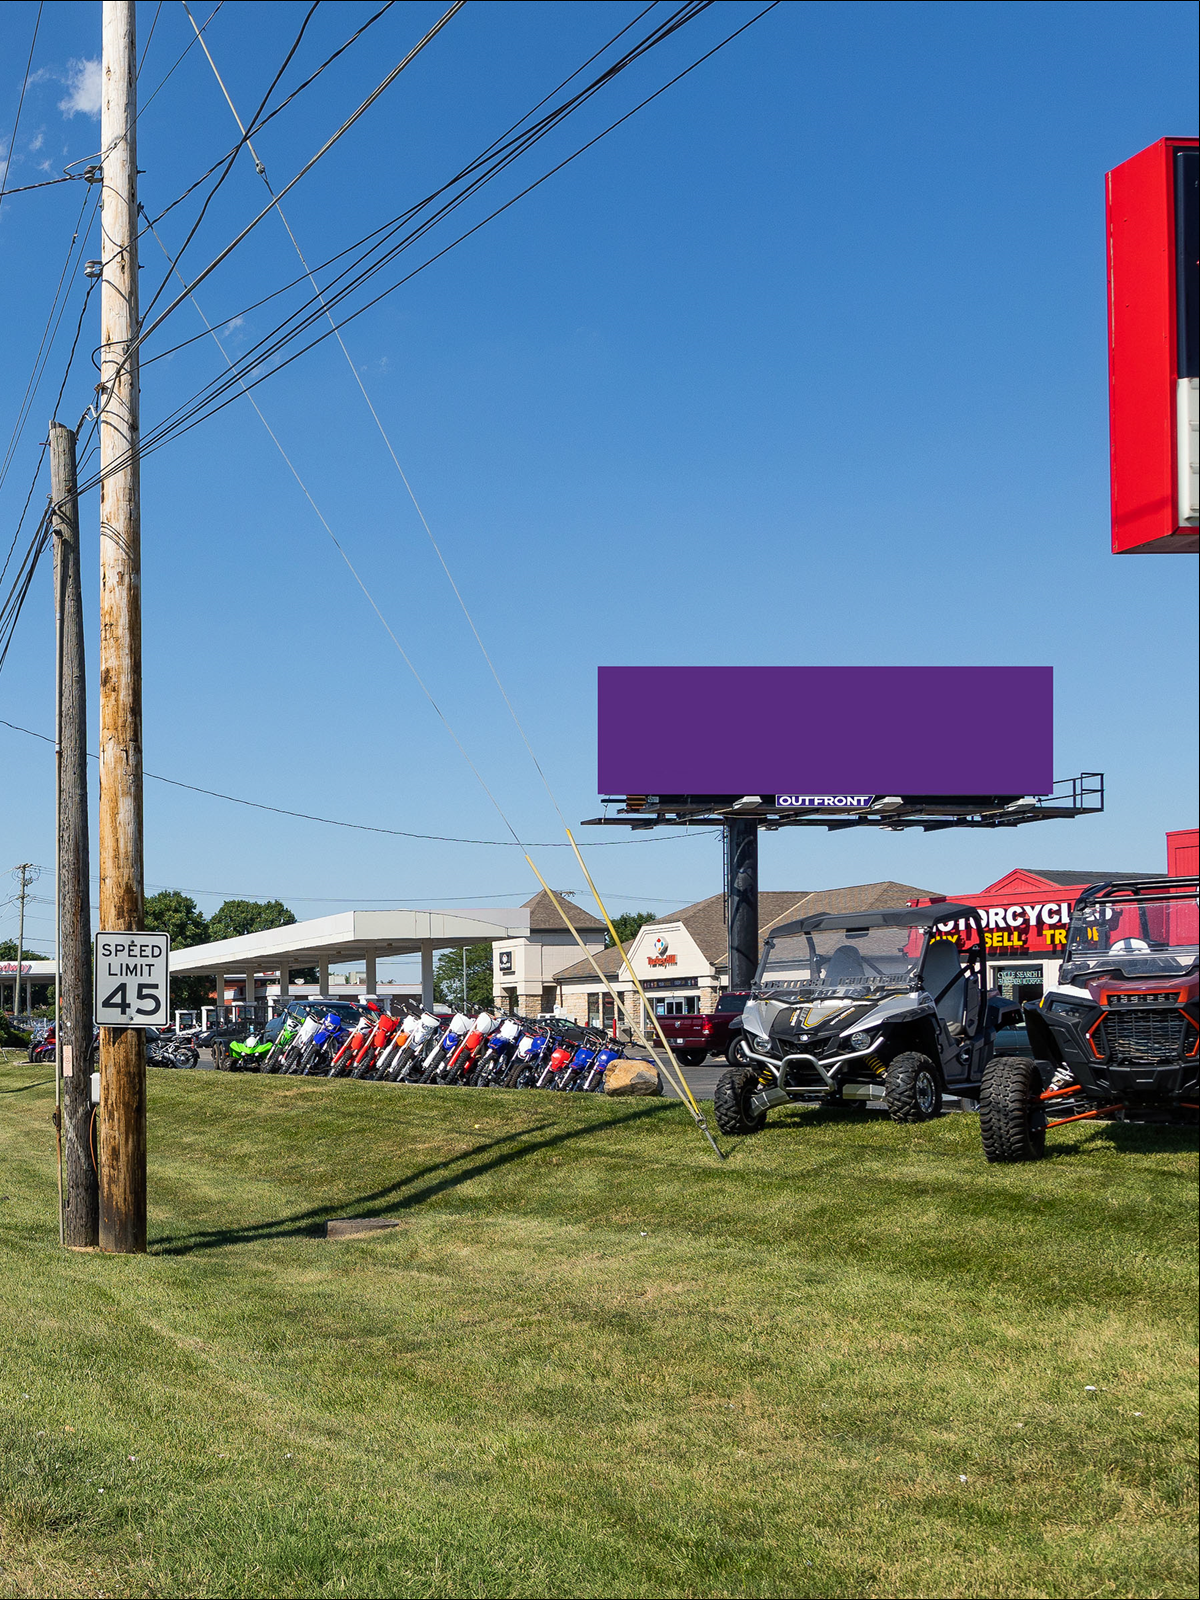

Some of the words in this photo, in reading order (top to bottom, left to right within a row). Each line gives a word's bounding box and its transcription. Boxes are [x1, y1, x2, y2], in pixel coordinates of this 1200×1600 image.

[779, 796, 869, 806] OUTFRONT
[918, 902, 1113, 932] OORCYCLS
[985, 931, 1023, 947] SELL
[1043, 926, 1099, 945] TRE
[102, 944, 162, 958] SPEED
[108, 963, 155, 977] LIMIT
[1016, 970, 1038, 978] SEARCH
[102, 982, 162, 1016] 45
